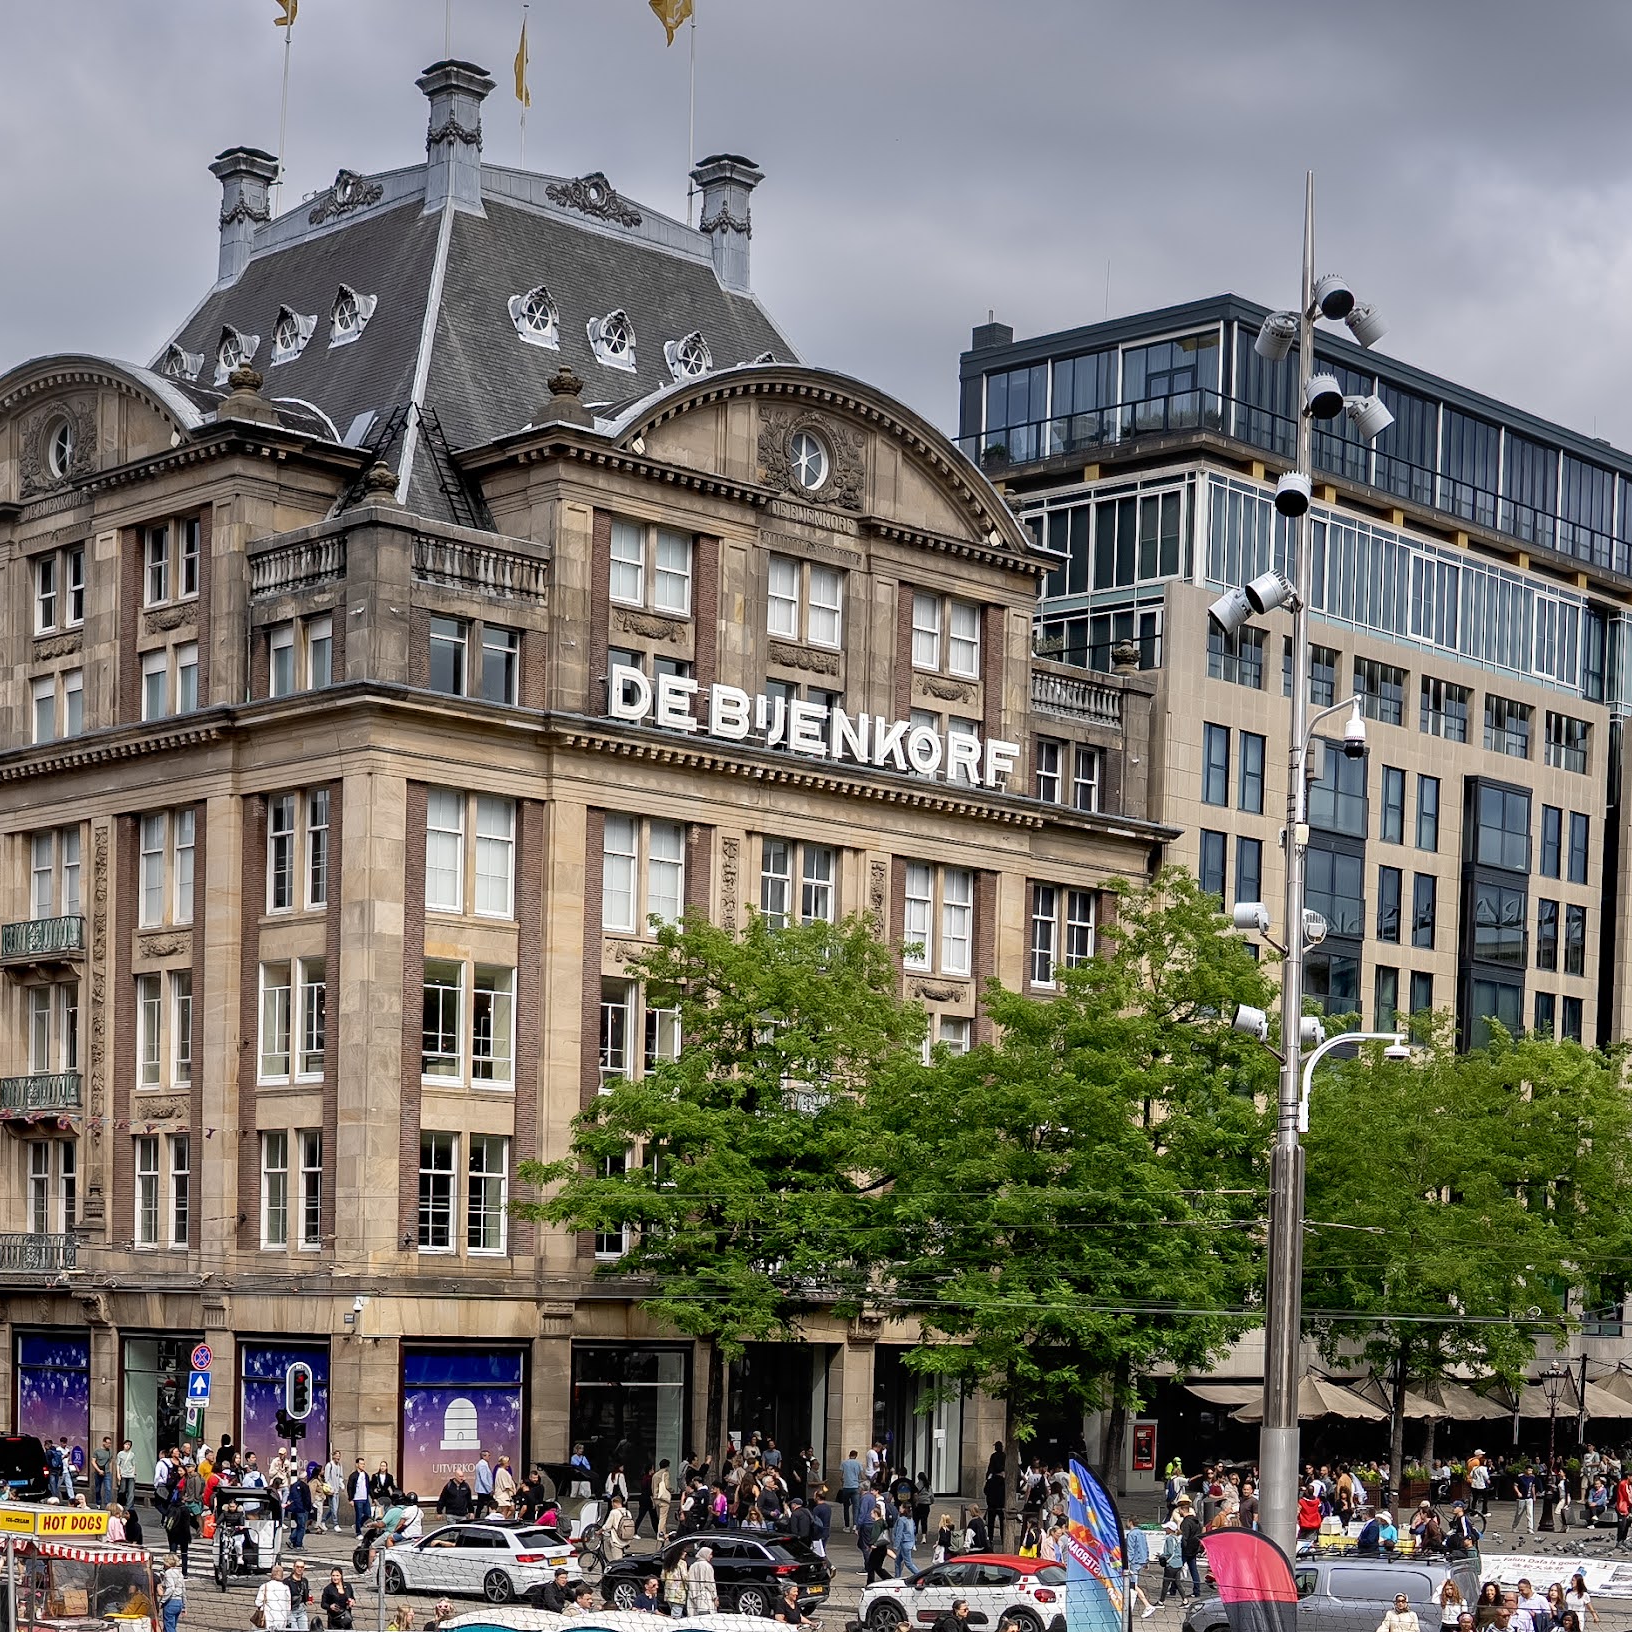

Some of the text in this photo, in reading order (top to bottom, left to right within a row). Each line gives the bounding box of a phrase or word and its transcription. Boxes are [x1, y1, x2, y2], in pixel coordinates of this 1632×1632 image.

[607, 662, 1021, 790] DE BIJENKORF
[432, 1462, 476, 1474] UITVERKO
[42, 1512, 103, 1531] HOT DOGS
